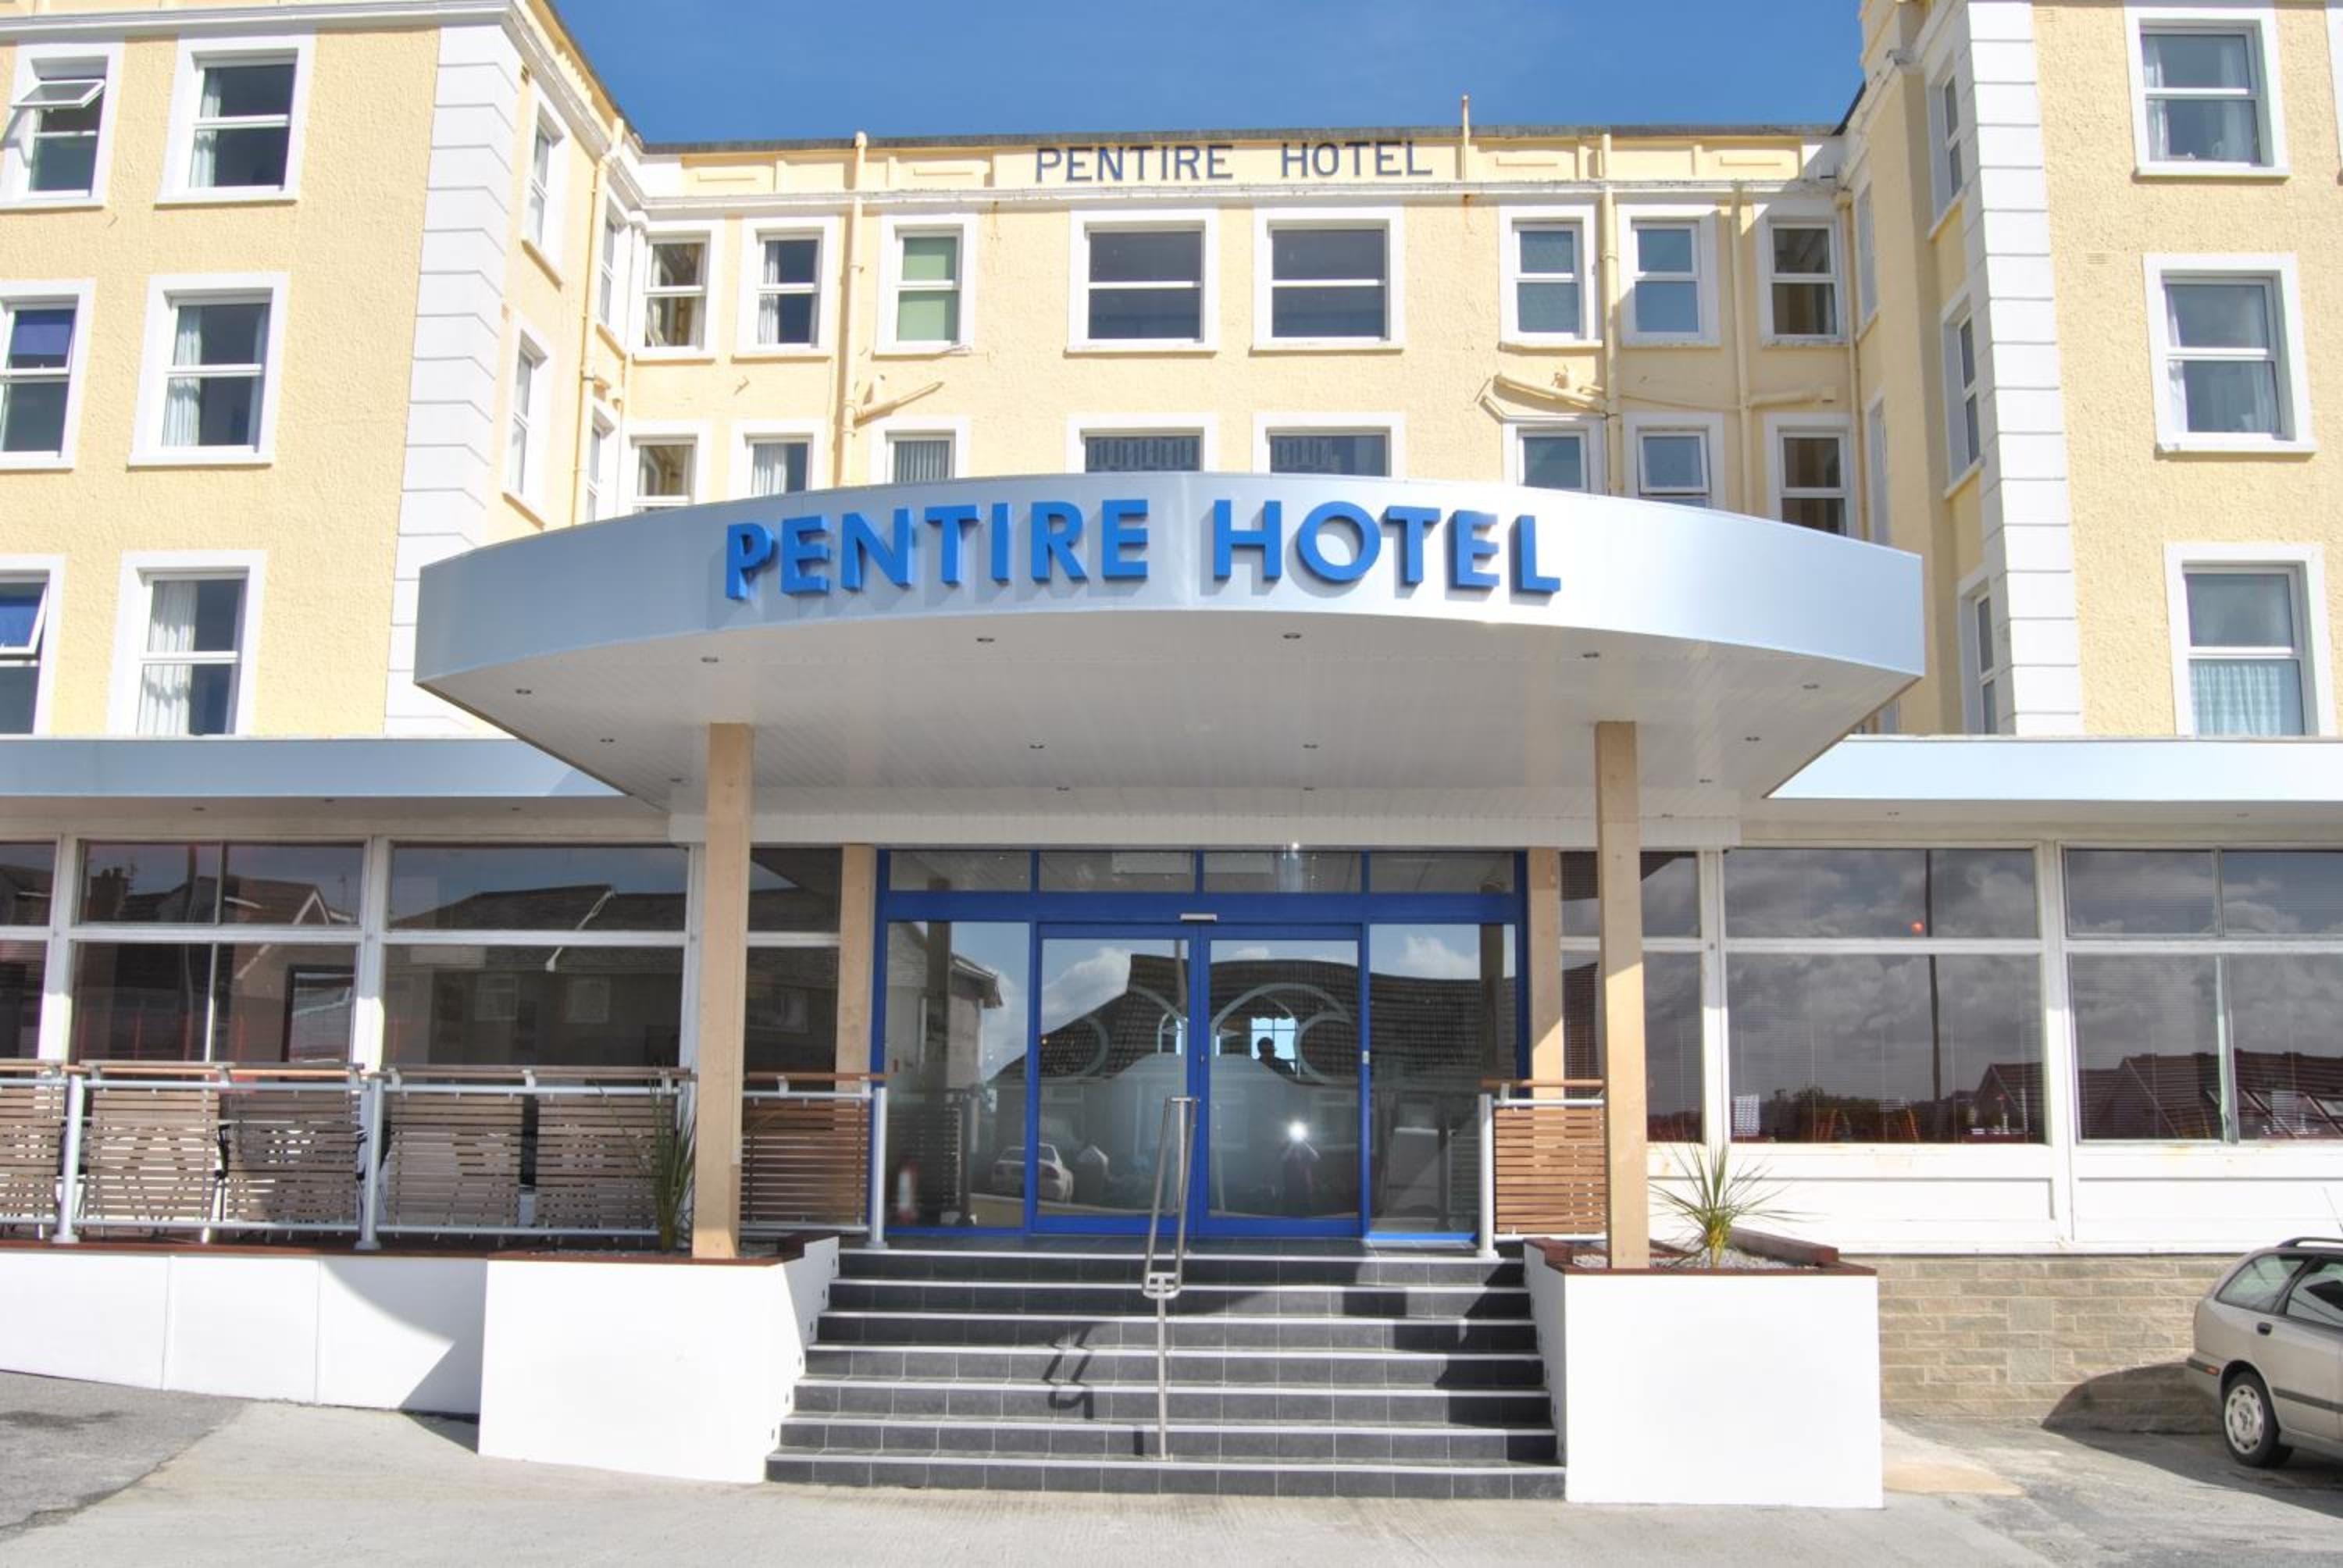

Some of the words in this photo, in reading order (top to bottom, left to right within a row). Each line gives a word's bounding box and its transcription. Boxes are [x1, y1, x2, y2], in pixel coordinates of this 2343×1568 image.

[1036, 144, 1233, 183] PENTIRE
[1281, 141, 1432, 178] HOTEL
[726, 499, 1148, 600] PENTIRE
[1214, 499, 1562, 594] HOTEL
